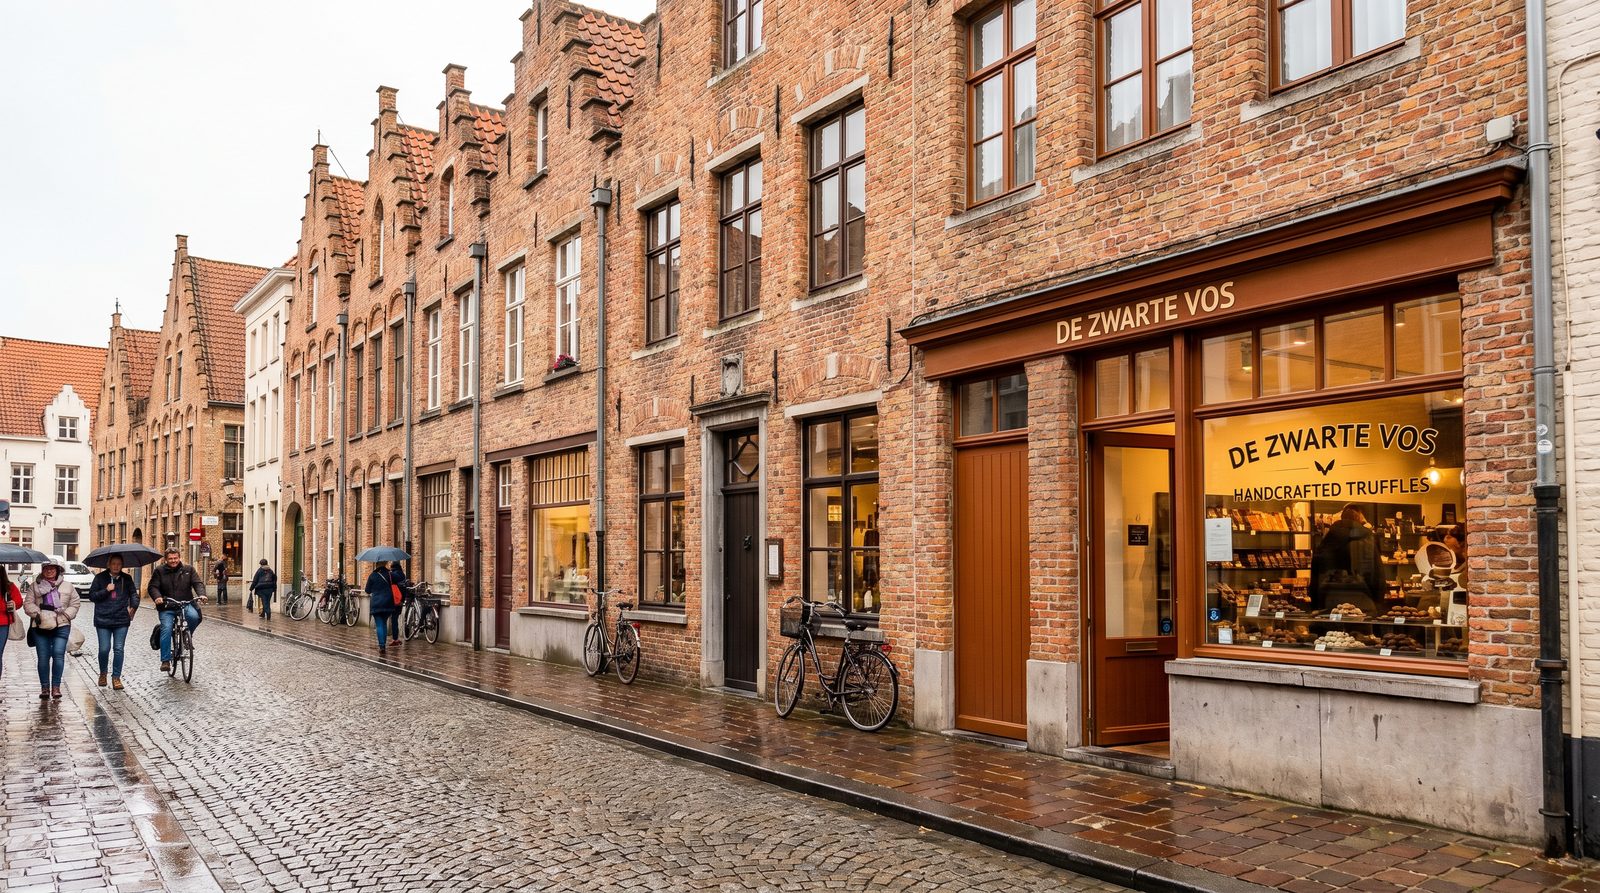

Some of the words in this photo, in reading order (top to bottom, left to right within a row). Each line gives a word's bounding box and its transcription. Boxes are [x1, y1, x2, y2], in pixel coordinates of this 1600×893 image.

[1056, 317, 1083, 344] DE
[1088, 294, 1178, 337] ZWARTE
[1184, 281, 1235, 316] VOS
[1228, 440, 1260, 469] DE
[1264, 423, 1370, 458] ZWARTE
[1379, 423, 1438, 455] VOS
[1233, 482, 1342, 502] HANDCRAFTED
[1346, 477, 1430, 497] TRUFFLES
